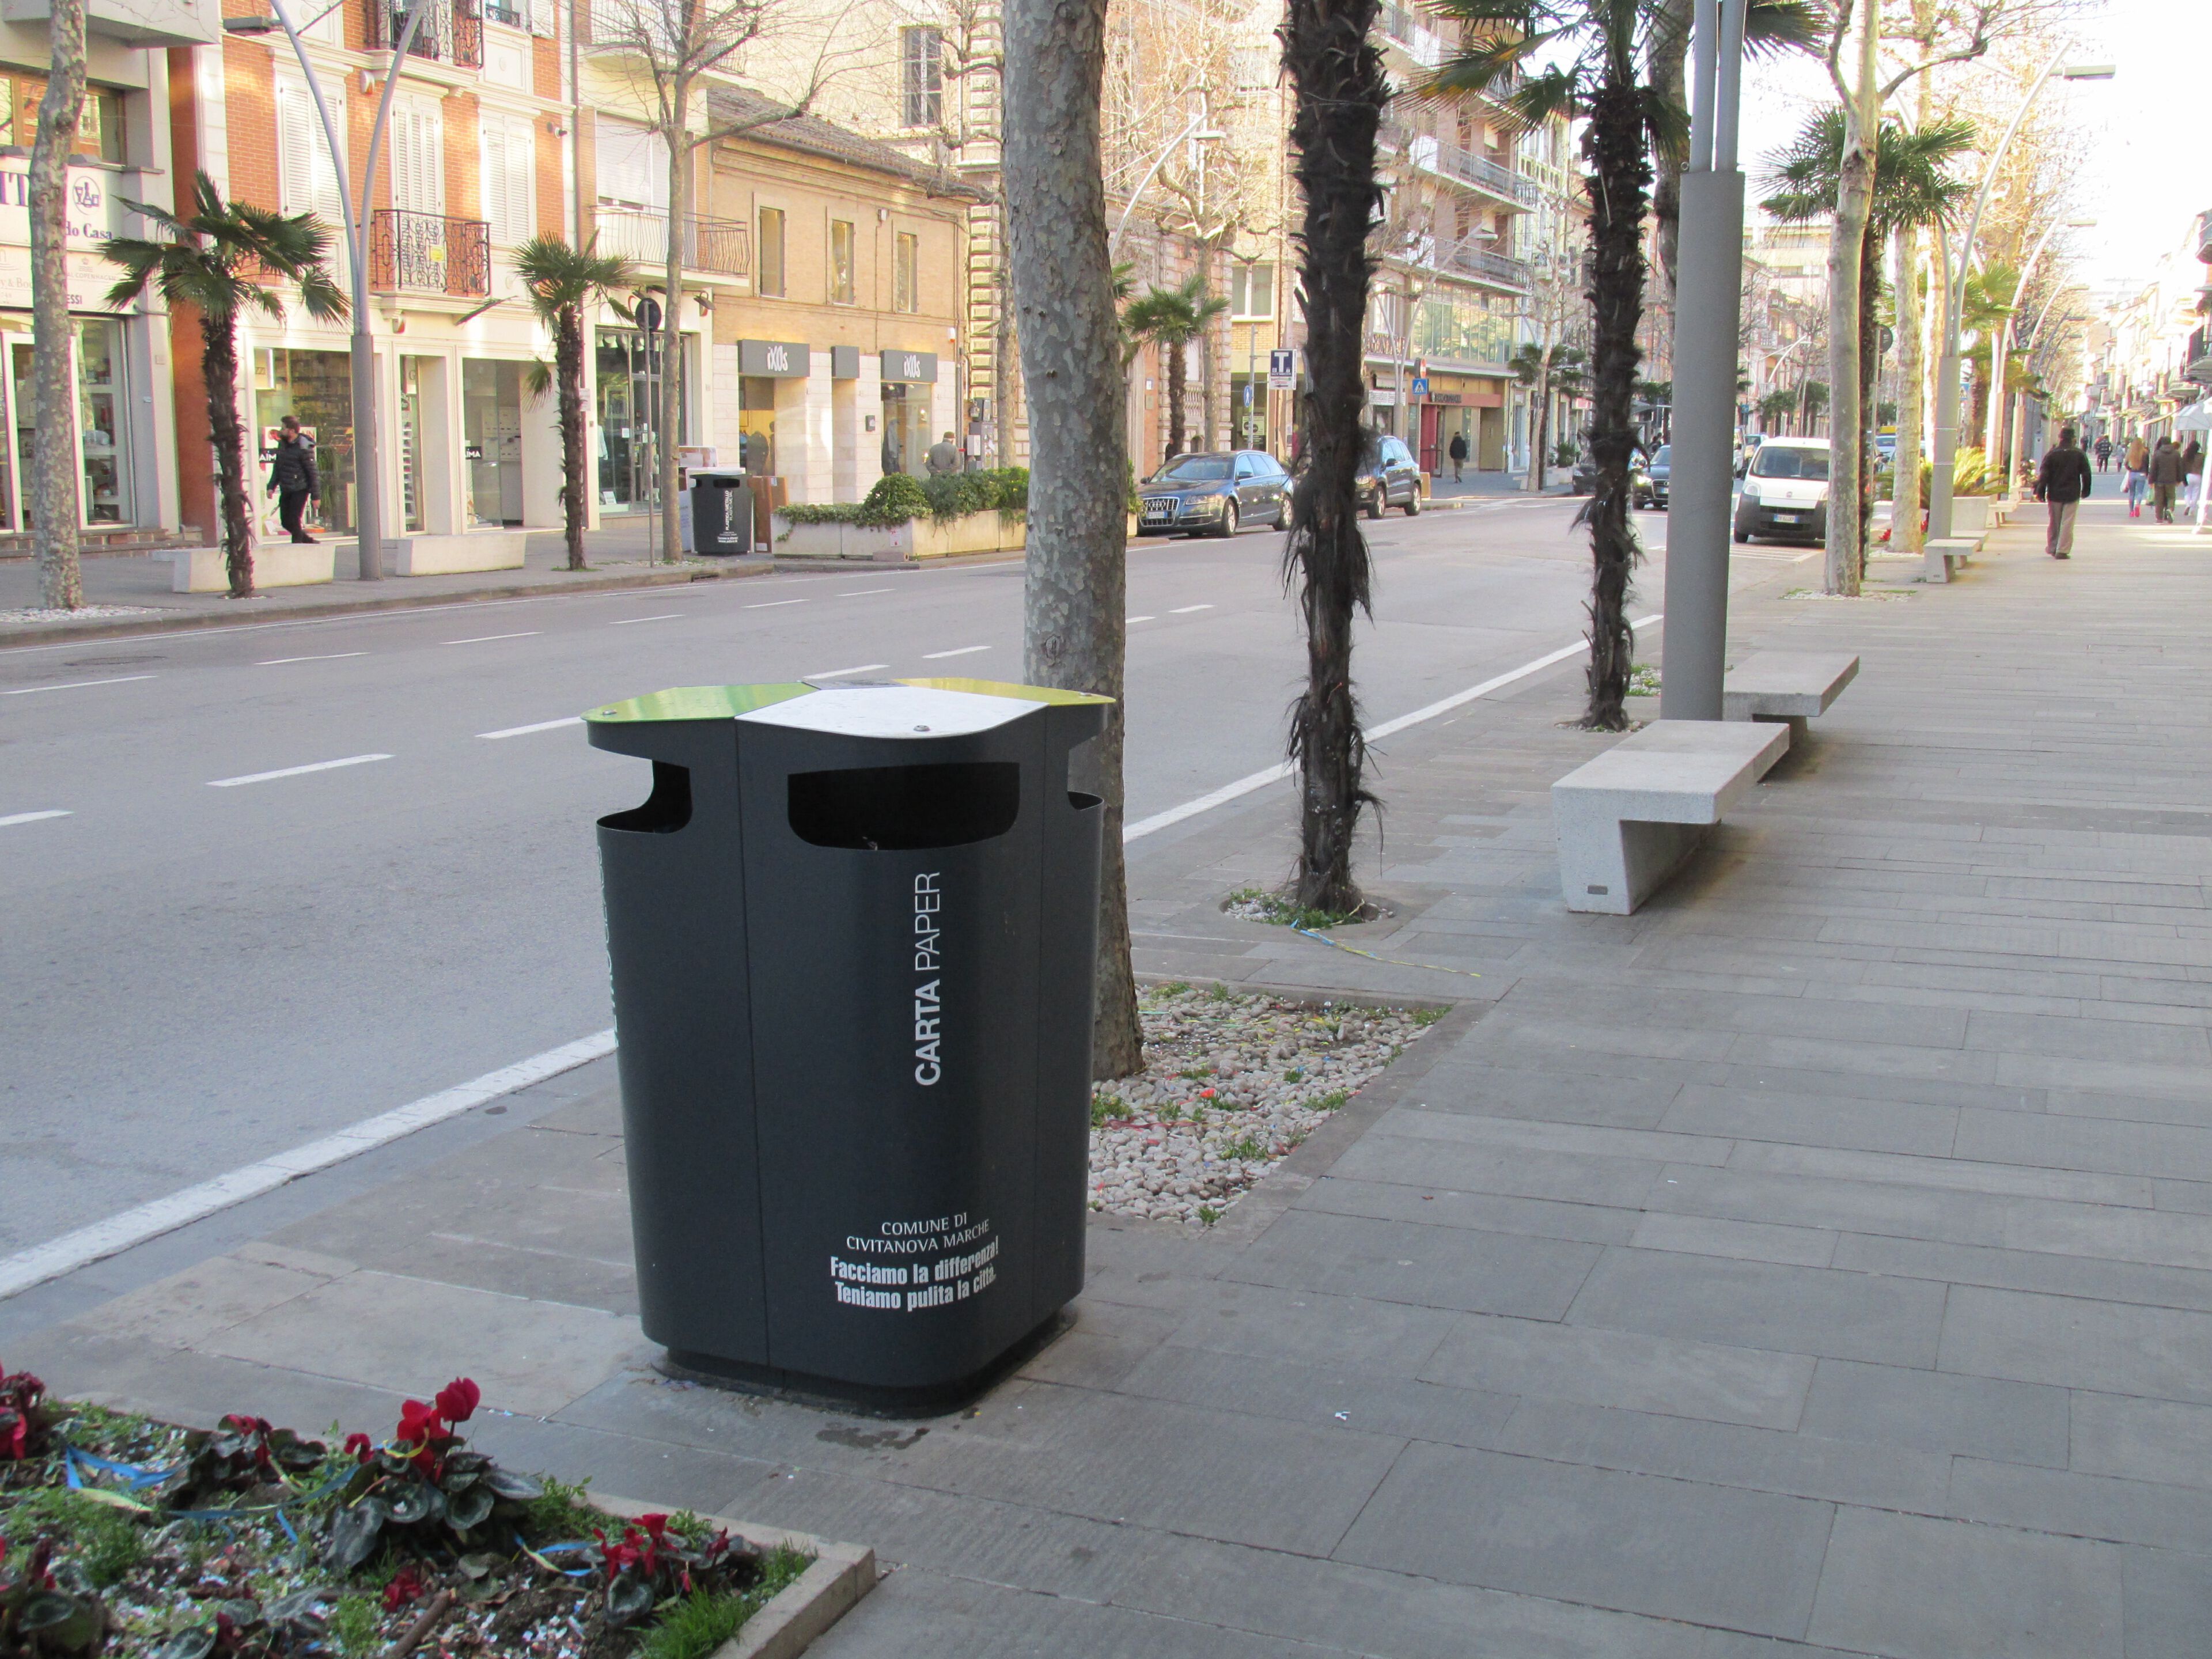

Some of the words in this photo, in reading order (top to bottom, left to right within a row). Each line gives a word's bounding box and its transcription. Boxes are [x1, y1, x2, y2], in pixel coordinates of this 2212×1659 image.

[83, 223, 113, 240] Casa
[915, 872, 940, 971] PAPER
[915, 979, 941, 1086] CARTA
[846, 1236, 938, 1253] CIVITANOVA
[944, 1218, 990, 1248] MARCHE
[881, 1217, 949, 1236] COMUNE
[954, 1212, 967, 1228] DI
[830, 1256, 908, 1285] Facciamo
[913, 1263, 929, 1284] la
[934, 1235, 999, 1281] differenza!
[835, 1281, 902, 1309] Teniamo
[907, 1285, 954, 1312] pulita
[957, 1279, 969, 1300] la
